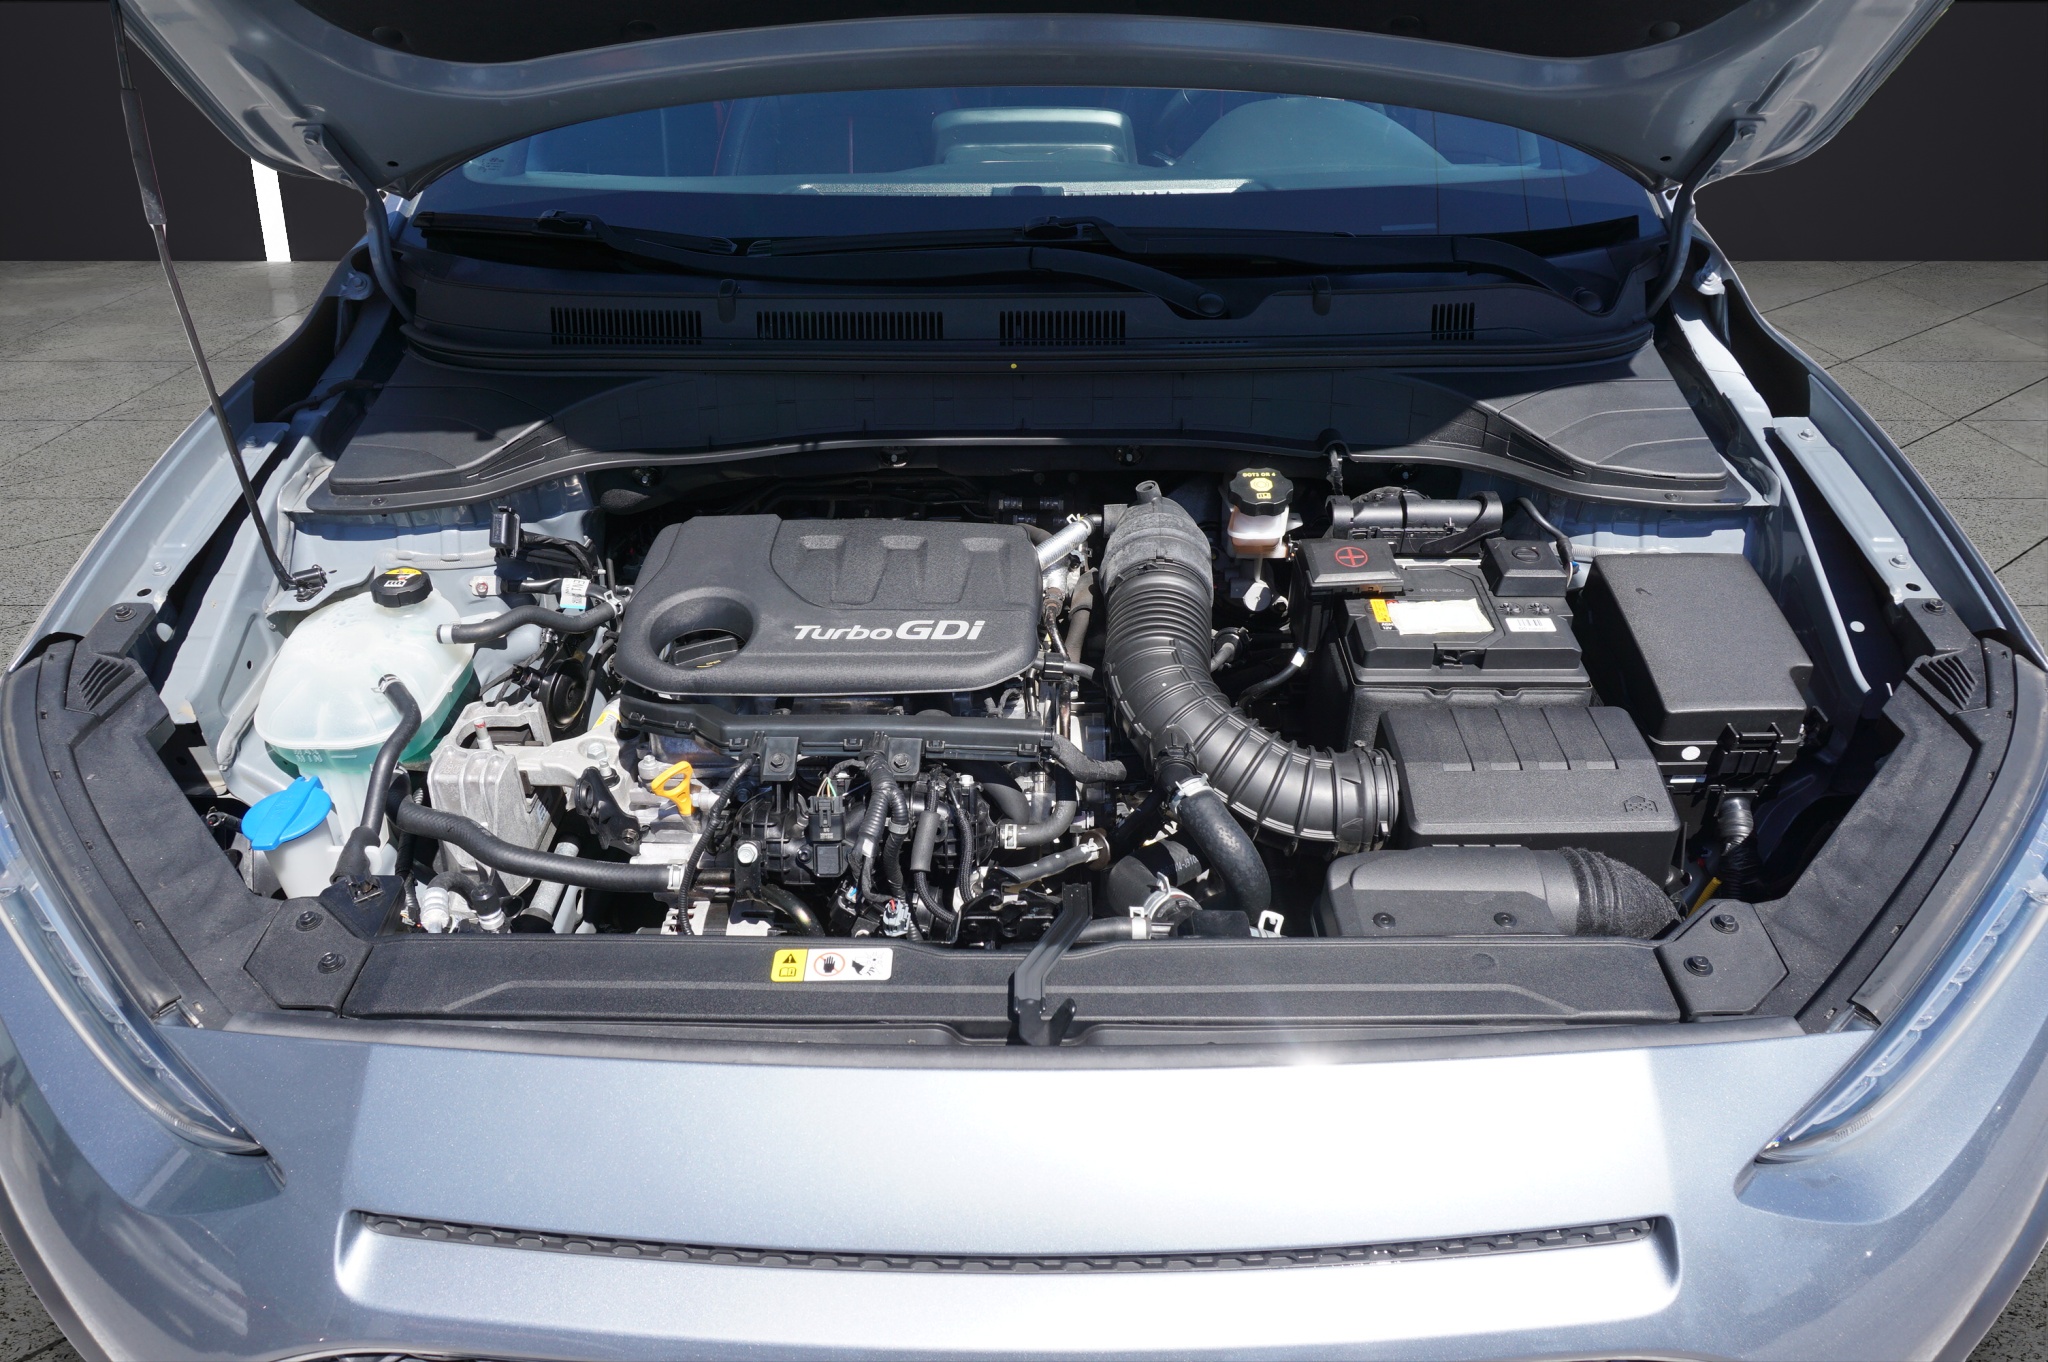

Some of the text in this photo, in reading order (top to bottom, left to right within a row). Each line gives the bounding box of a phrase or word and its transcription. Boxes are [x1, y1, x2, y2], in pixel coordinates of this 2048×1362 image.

[793, 619, 986, 640] Turbo GDi
[295, 754, 323, 763] MIN
